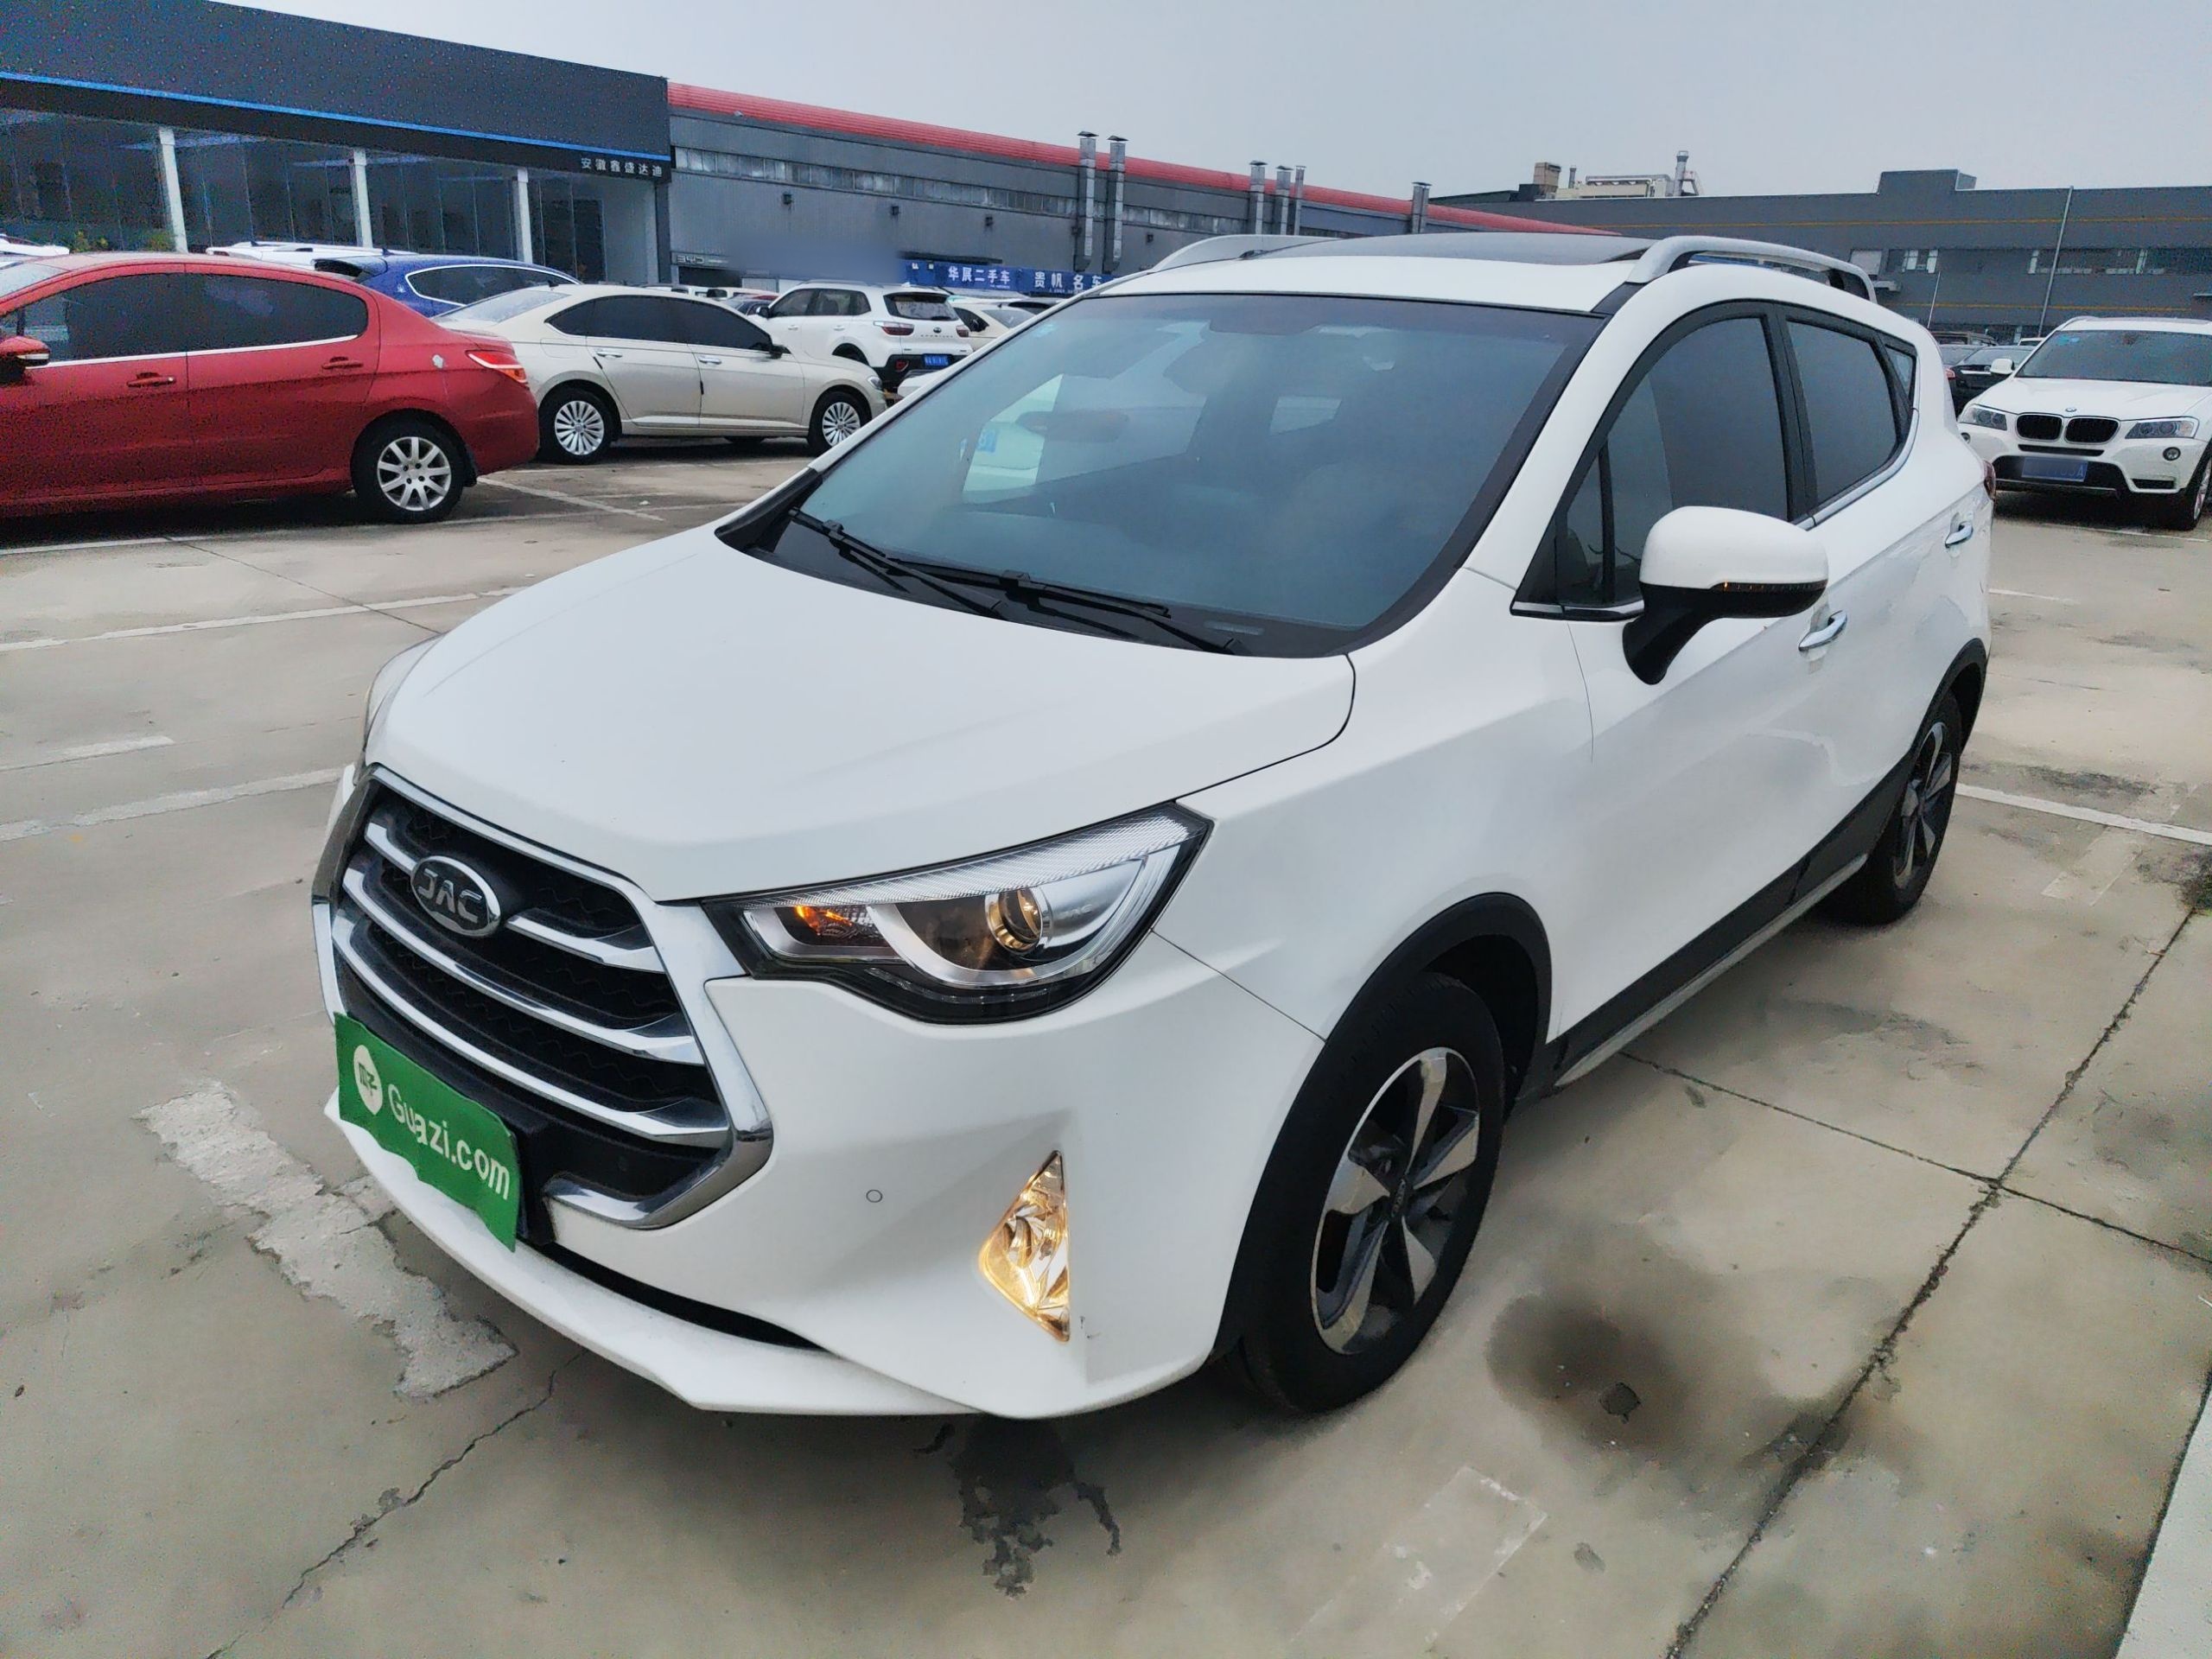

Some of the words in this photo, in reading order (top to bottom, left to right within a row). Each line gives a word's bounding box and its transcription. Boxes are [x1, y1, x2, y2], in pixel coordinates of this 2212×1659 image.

[948, 265, 1010, 285] 华展二手车
[417, 868, 482, 924] JAC
[388, 1084, 511, 1200] Guazi.com
